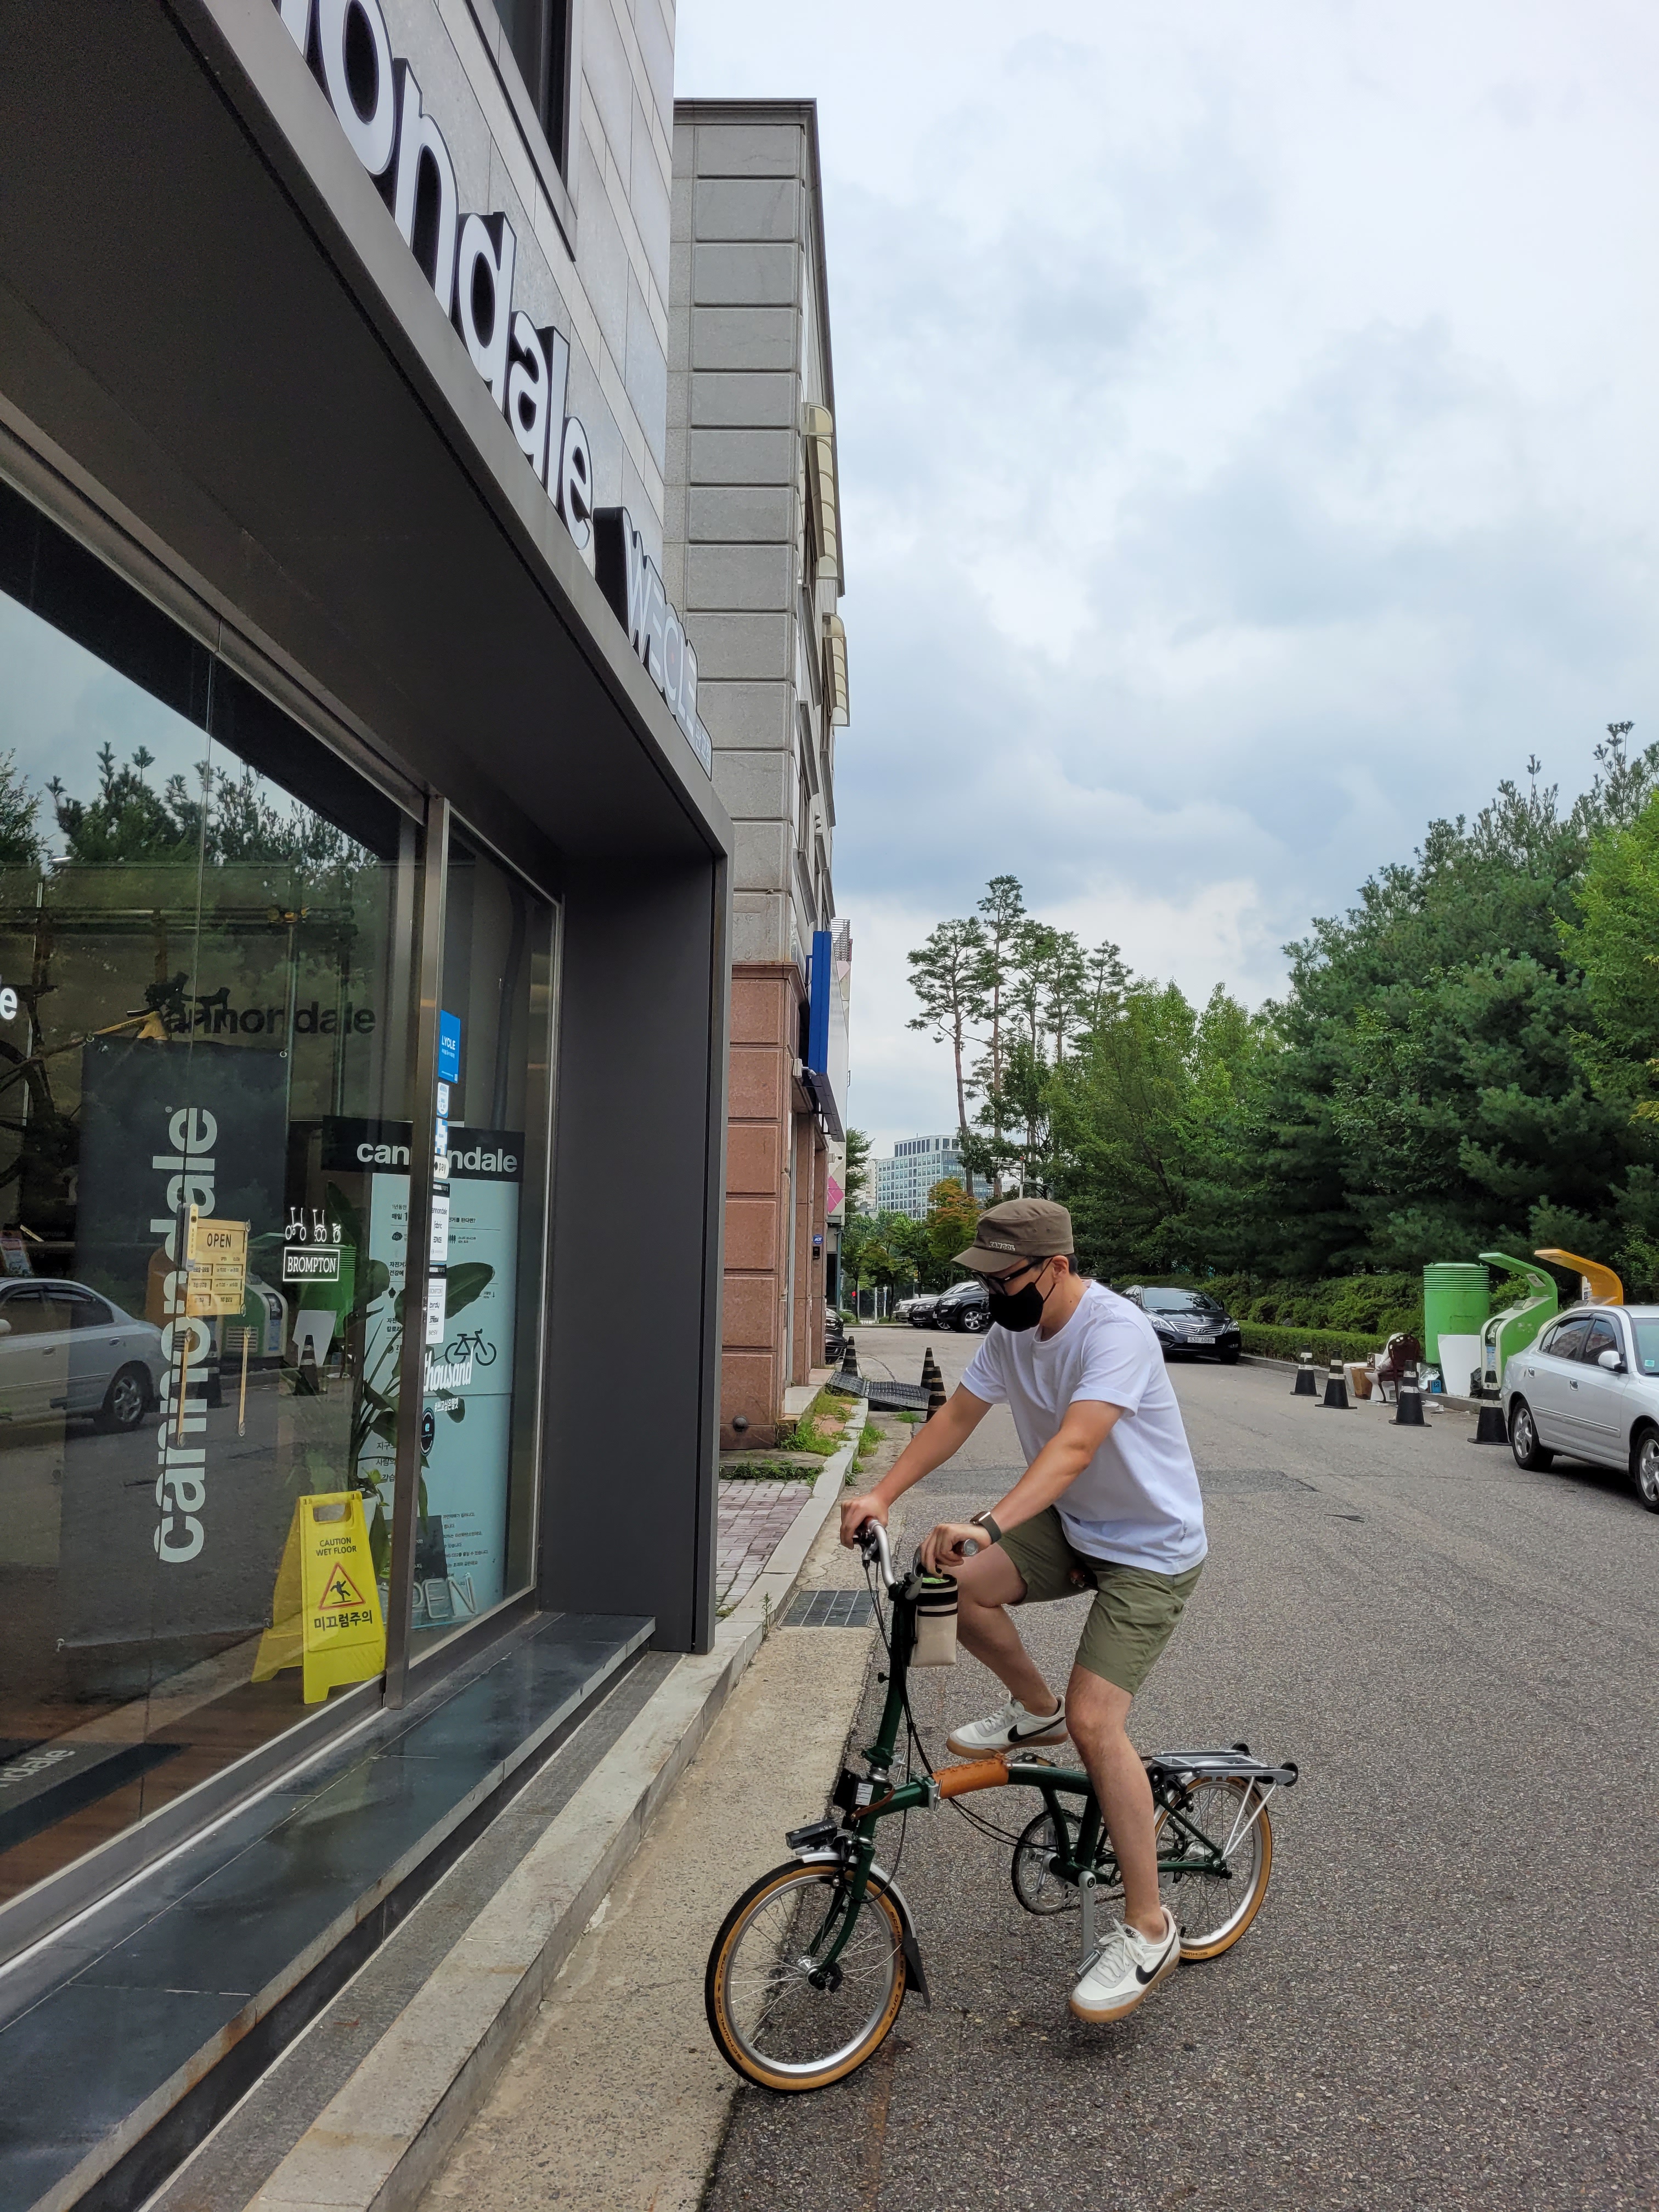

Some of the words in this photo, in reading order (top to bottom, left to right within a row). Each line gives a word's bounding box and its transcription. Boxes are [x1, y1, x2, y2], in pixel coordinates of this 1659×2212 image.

[441, 1035, 456, 1051] LYCLE
[357, 1143, 517, 1173] canndale
[438, 1163, 447, 1174] pay
[207, 1233, 232, 1248] OPEN
[989, 1241, 1016, 1251] KANGOL
[287, 1256, 337, 1274] BROMPTON
[423, 1346, 474, 1392] thousand
[319, 1537, 352, 1547] CAUTION
[334, 1545, 357, 1554] FLOOR
[314, 1610, 373, 1631] 미끄럼주의
